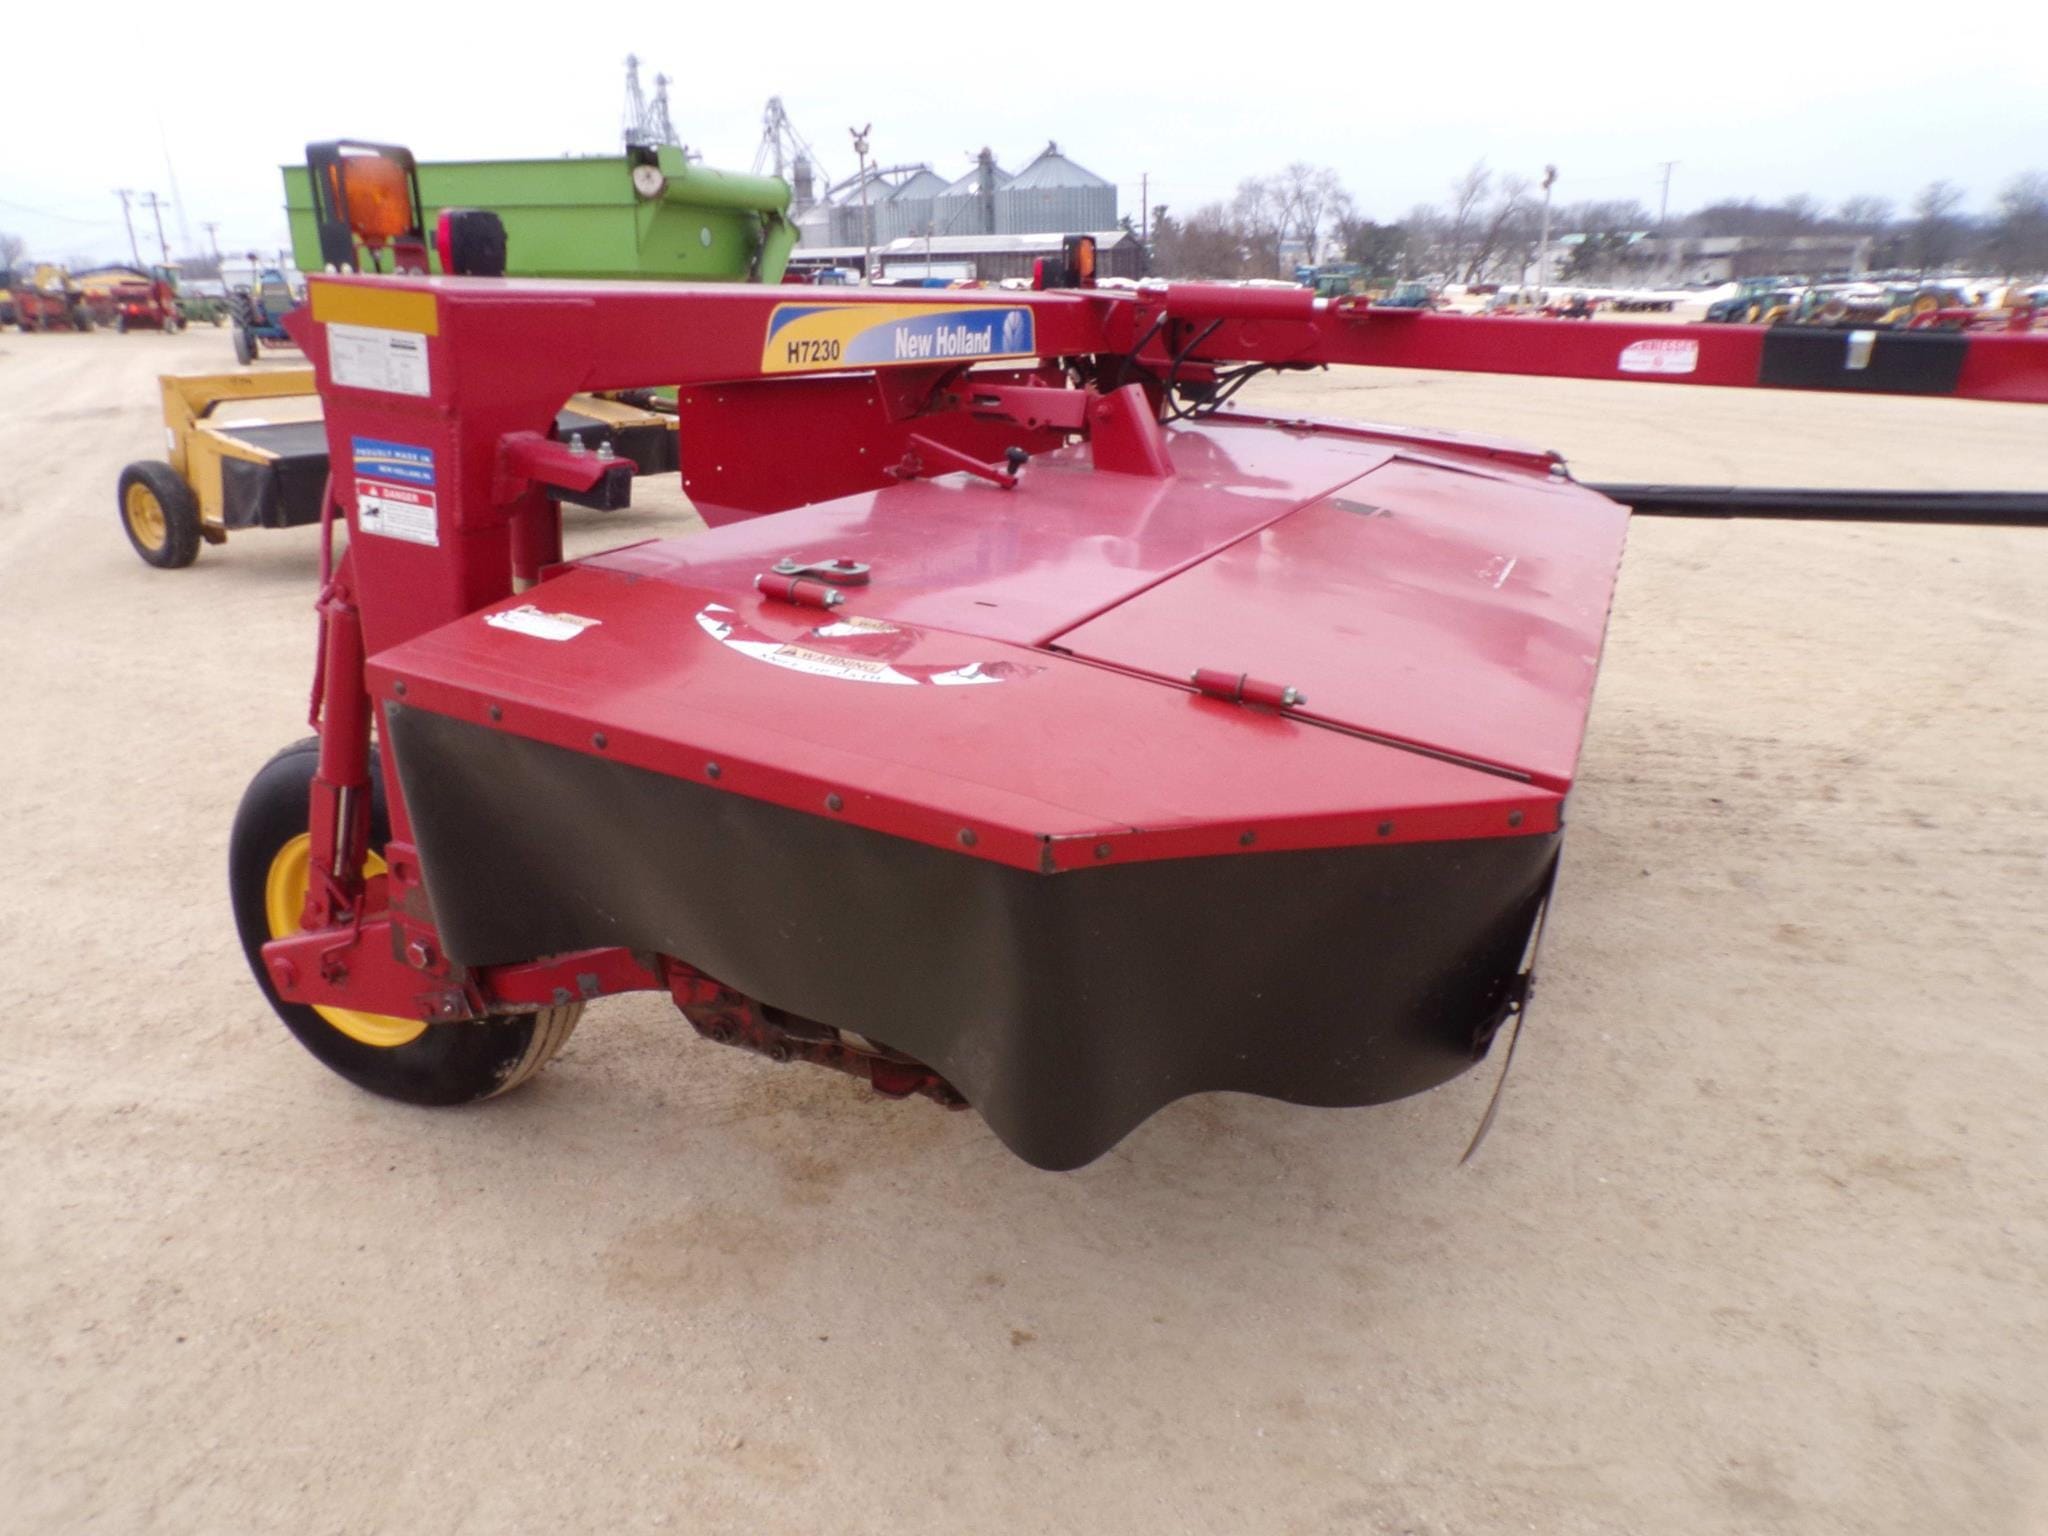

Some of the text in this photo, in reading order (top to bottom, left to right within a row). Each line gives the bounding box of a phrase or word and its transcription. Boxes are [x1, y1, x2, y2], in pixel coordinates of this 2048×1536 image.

[787, 339, 841, 364] H7230
[895, 325, 992, 359] New Holland
[395, 450, 418, 460] MADE
[419, 454, 431, 463] IN
[382, 487, 420, 503] DANGER
[802, 652, 878, 672] WARNING
